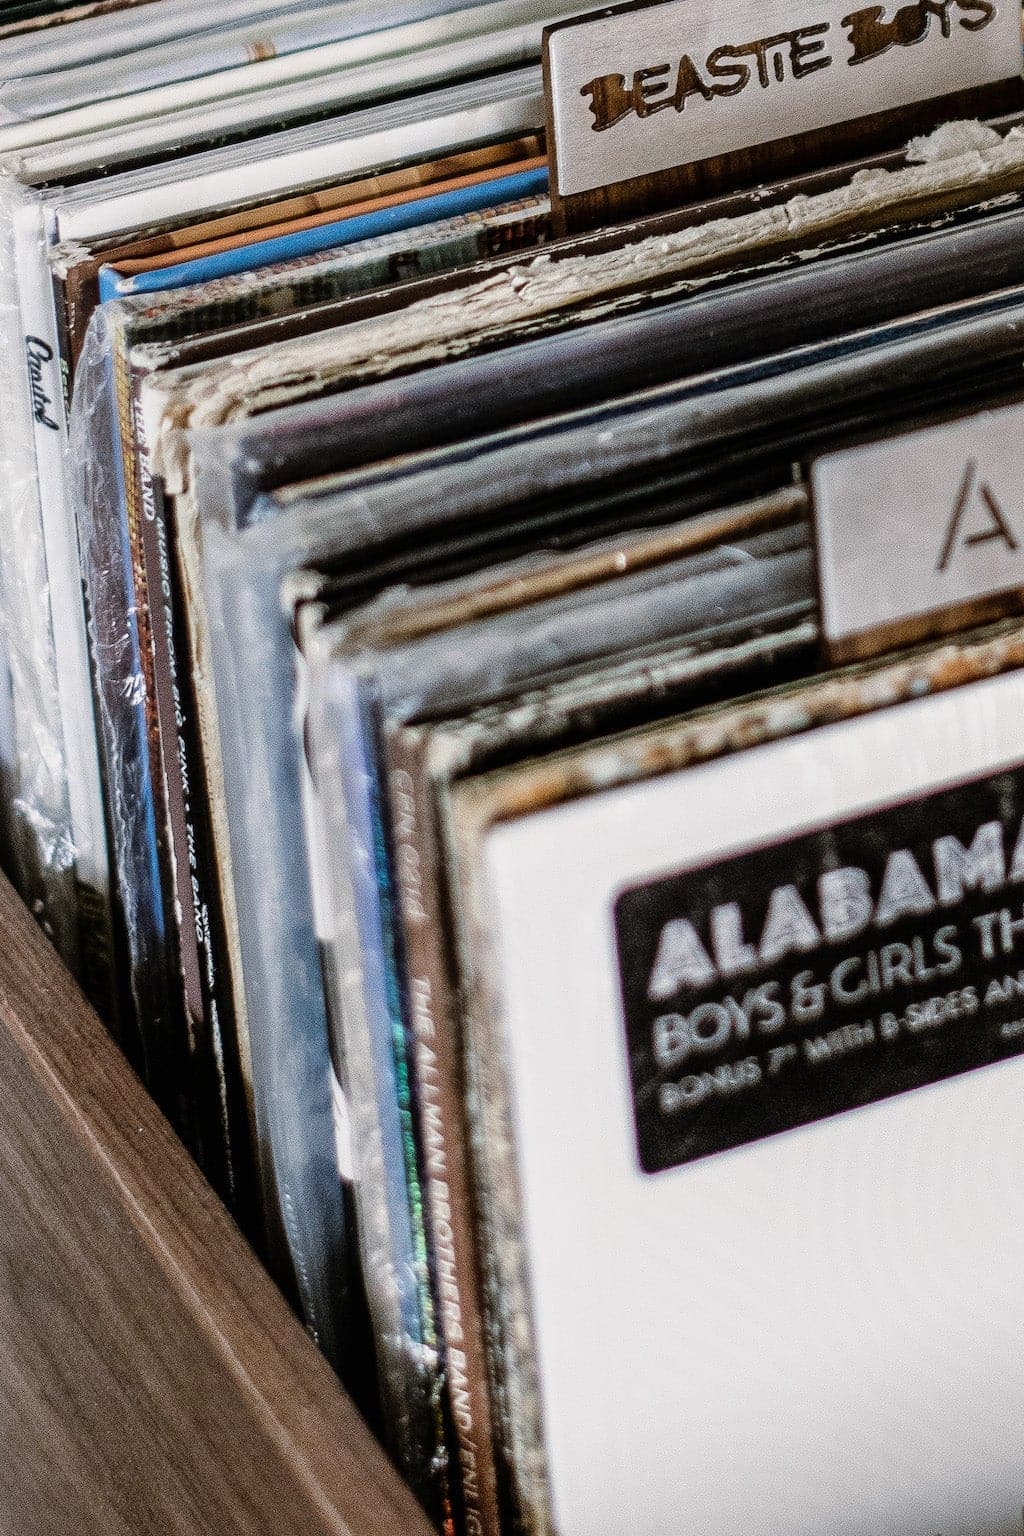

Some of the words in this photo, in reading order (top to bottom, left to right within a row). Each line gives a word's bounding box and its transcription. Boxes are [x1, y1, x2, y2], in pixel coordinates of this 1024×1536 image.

[579, 21, 832, 132] BEASTIE
[138, 452, 156, 522] BAND
[935, 458, 1020, 572] A
[164, 605, 177, 678] FROM
[177, 735, 190, 796] PINK
[186, 823, 197, 870] THE
[191, 874, 204, 943] BAND
[413, 977, 436, 1038] THE
[658, 1056, 763, 1113] BONUS
[804, 1019, 876, 1063] WITH
[417, 1040, 447, 1175] ALLMAN
[430, 1177, 464, 1342] BROTHERS
